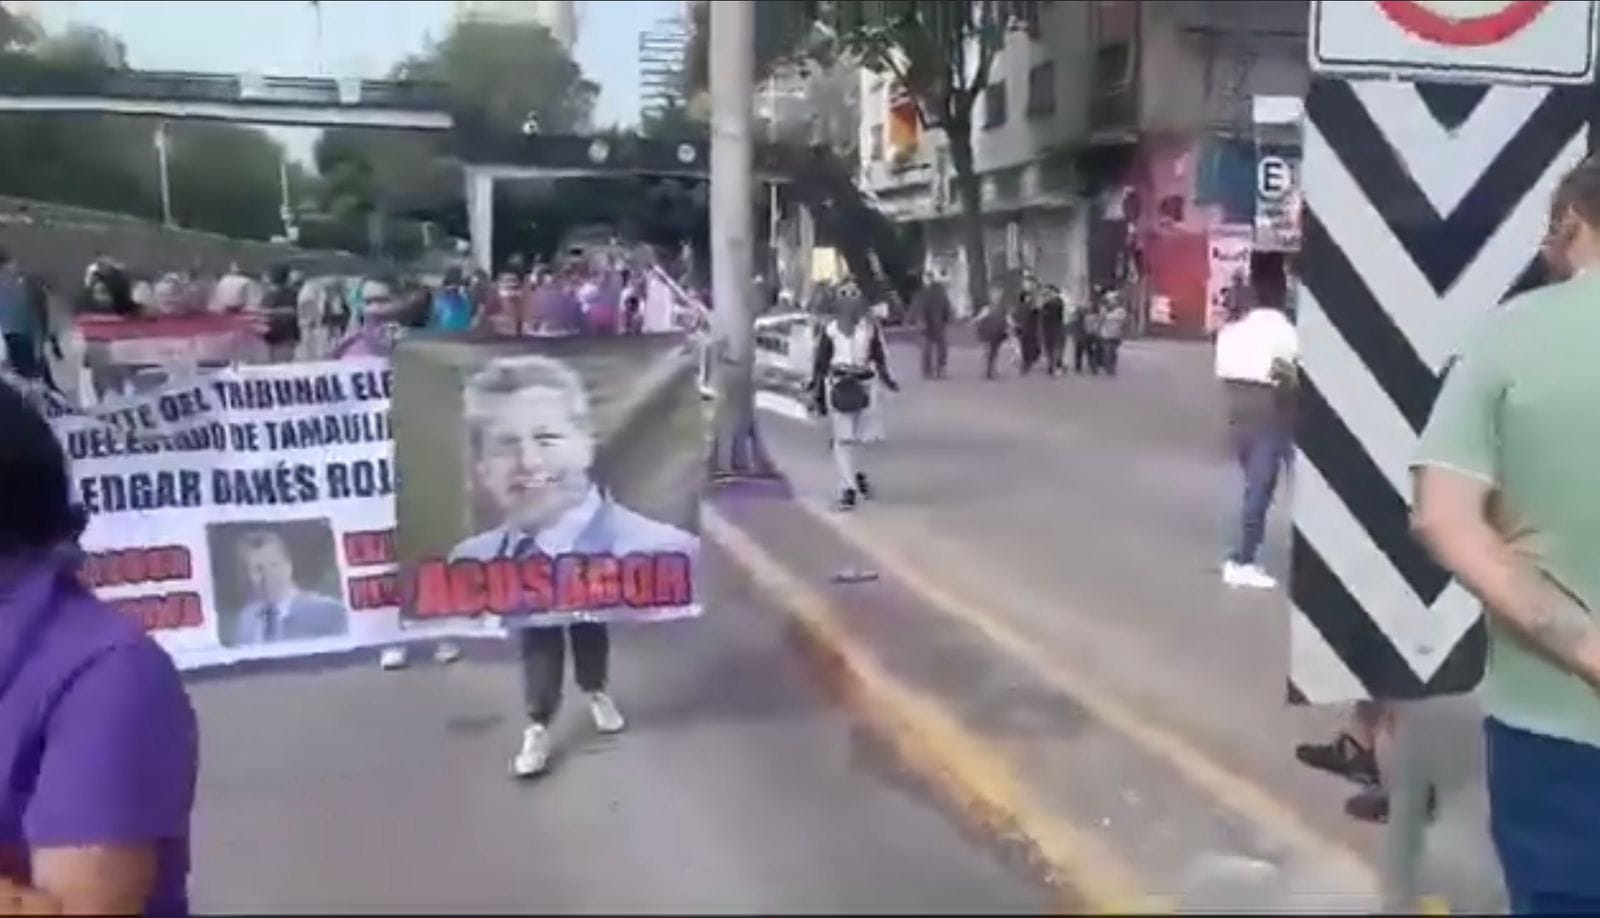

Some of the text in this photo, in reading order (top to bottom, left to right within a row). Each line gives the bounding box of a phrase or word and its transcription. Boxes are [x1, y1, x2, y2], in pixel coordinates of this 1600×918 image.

[1265, 162, 1282, 192] E
[213, 374, 347, 410] TRIBUNAL
[229, 422, 259, 451] DE
[80, 470, 201, 514] EDGAR
